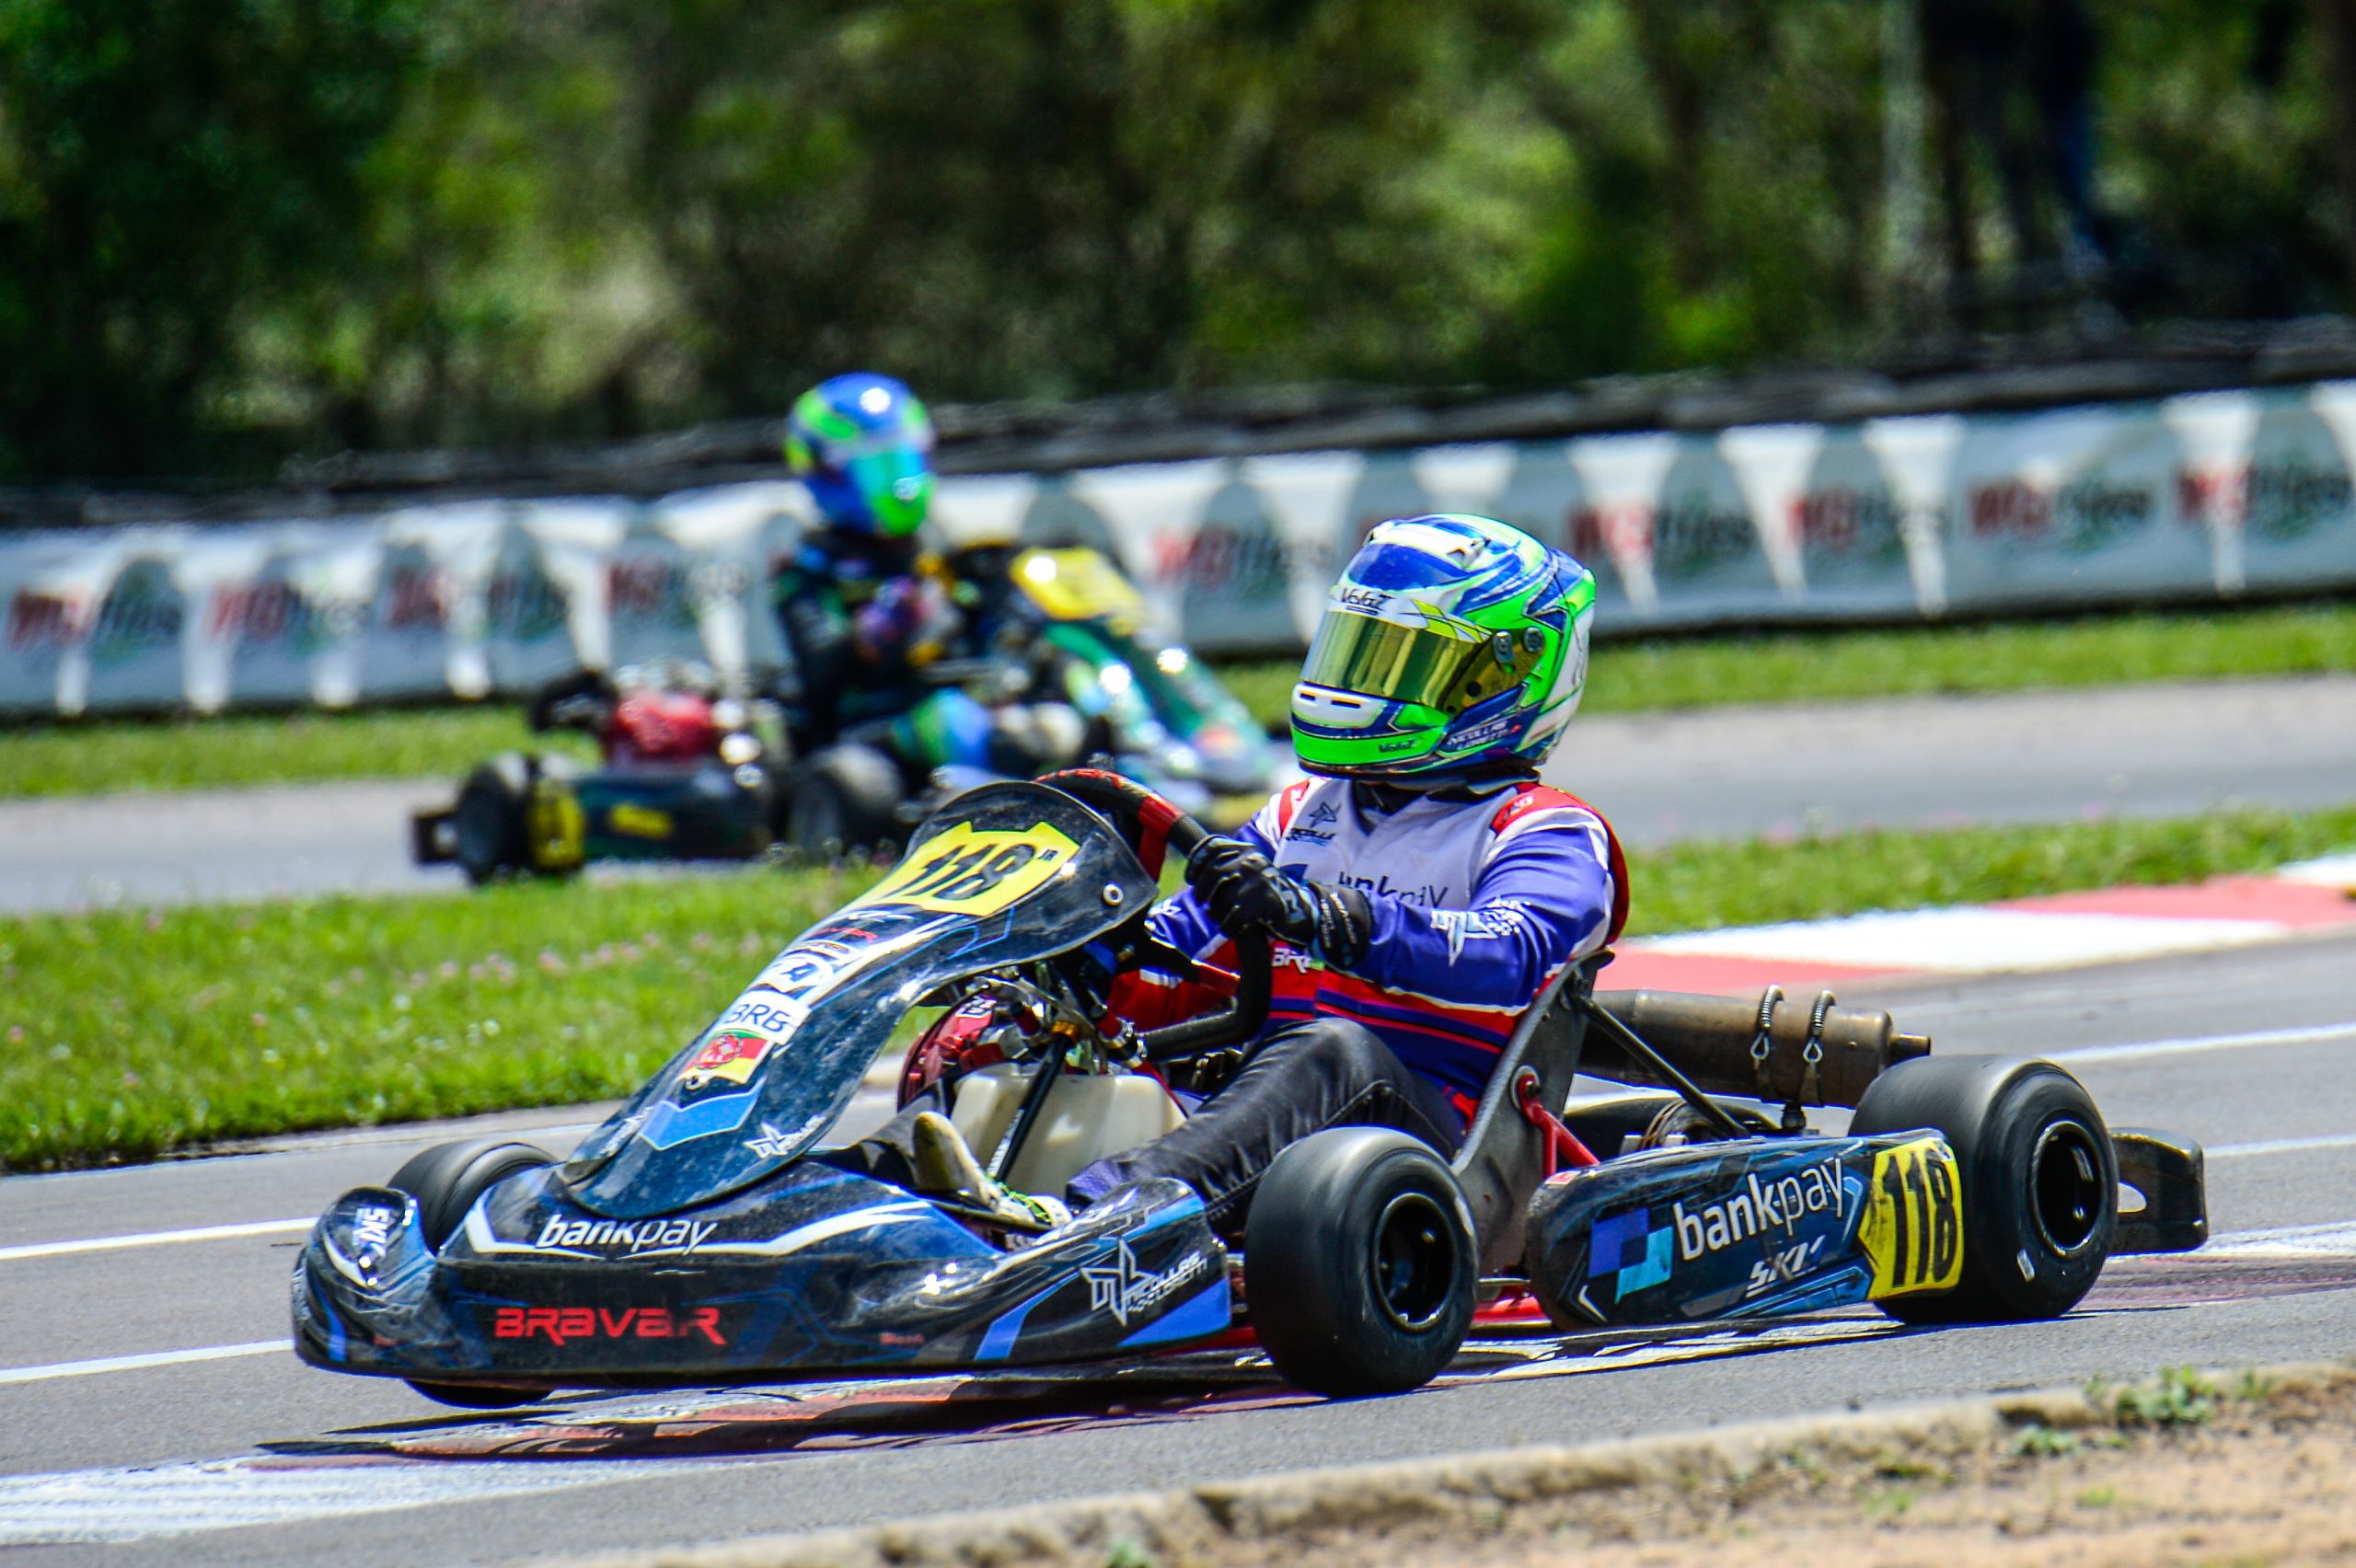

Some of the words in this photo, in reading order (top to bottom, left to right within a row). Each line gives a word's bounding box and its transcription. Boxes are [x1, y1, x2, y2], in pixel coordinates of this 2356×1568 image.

[882, 843, 1036, 901] 118
[535, 1214, 718, 1256] bankpay
[1673, 1158, 1842, 1261] bankpay
[1882, 1147, 1958, 1287] 118
[494, 1307, 727, 1346] BRAVAR
